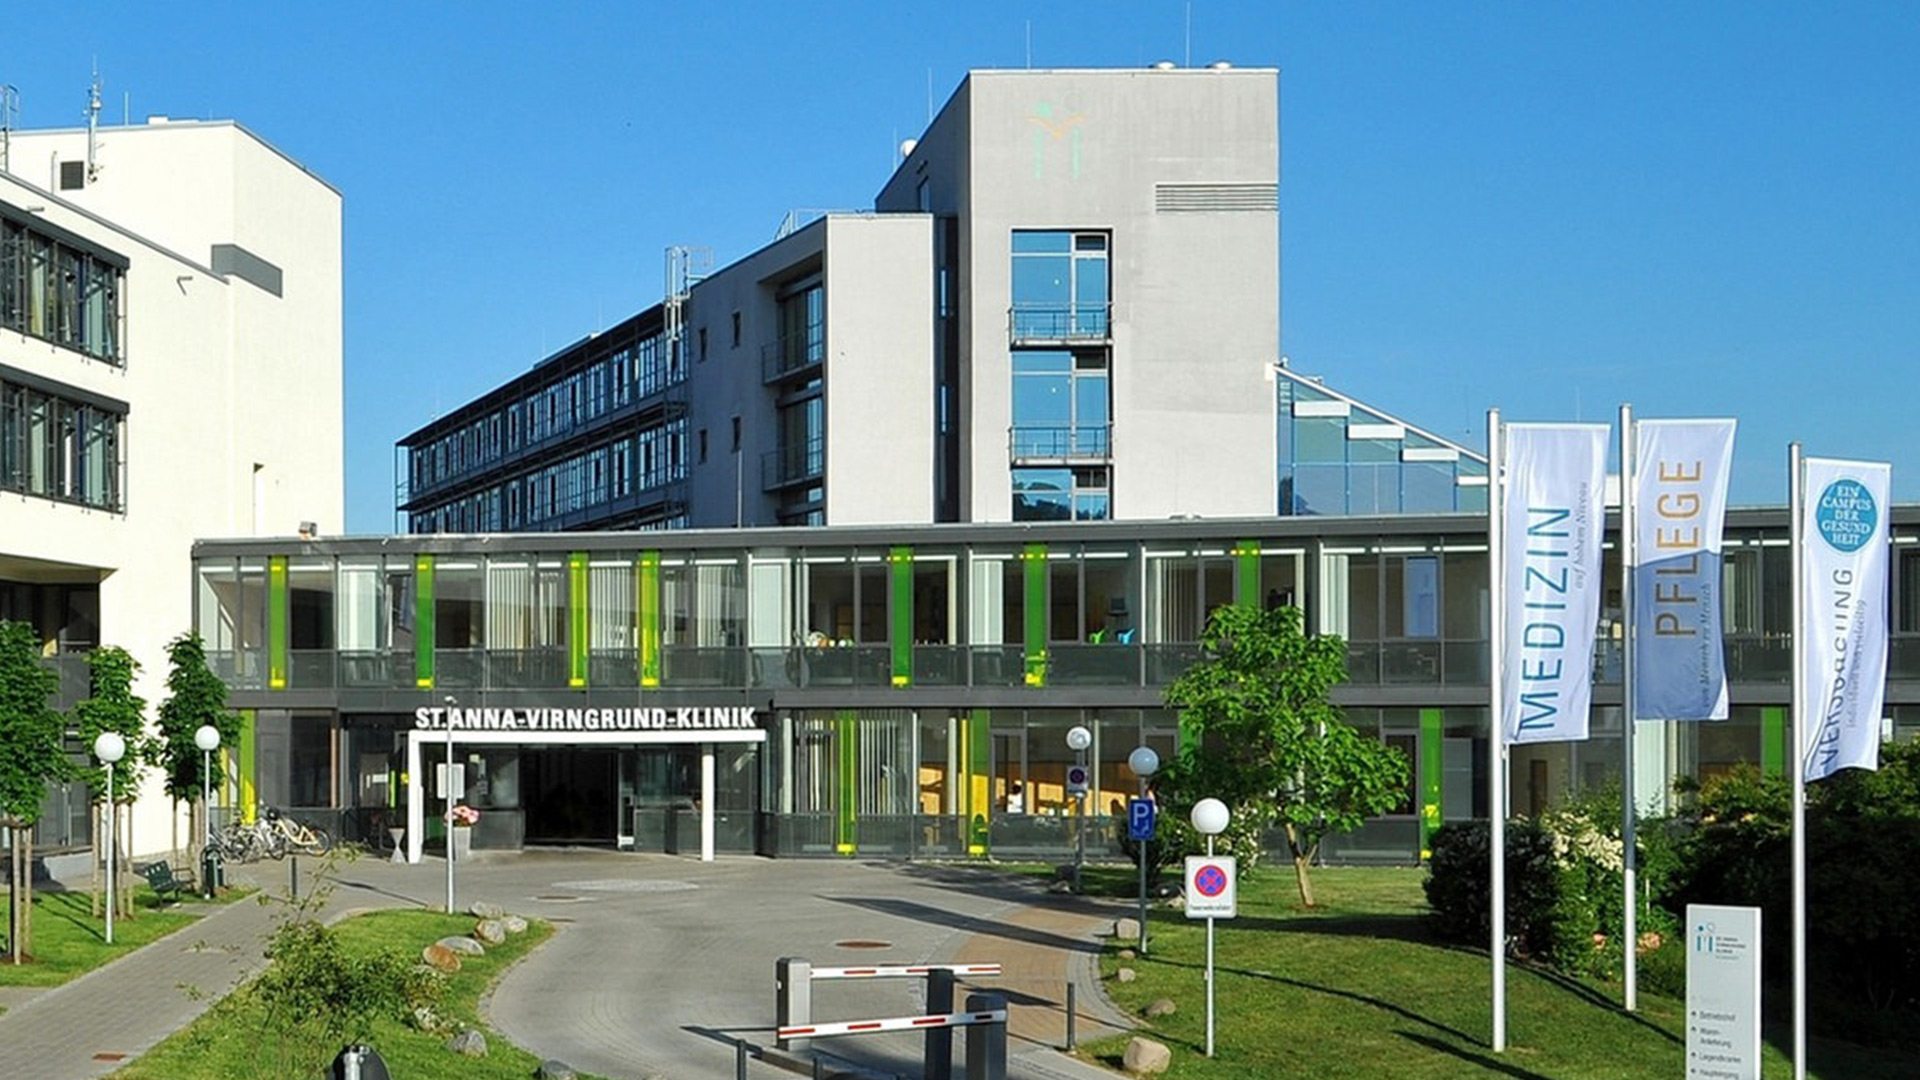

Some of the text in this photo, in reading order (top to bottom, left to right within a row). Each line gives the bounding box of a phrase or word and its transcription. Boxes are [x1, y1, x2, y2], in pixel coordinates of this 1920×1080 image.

[1837, 485, 1861, 497] EIN
[1821, 496, 1872, 511] CAMPUS
[1834, 509, 1860, 521] DER
[1821, 520, 1871, 535] GESUND
[1832, 532, 1861, 546] HEIT
[1654, 460, 1702, 639] PFLEGE
[1517, 506, 1571, 731] MEDIZIN
[1133, 802, 1150, 827] P
